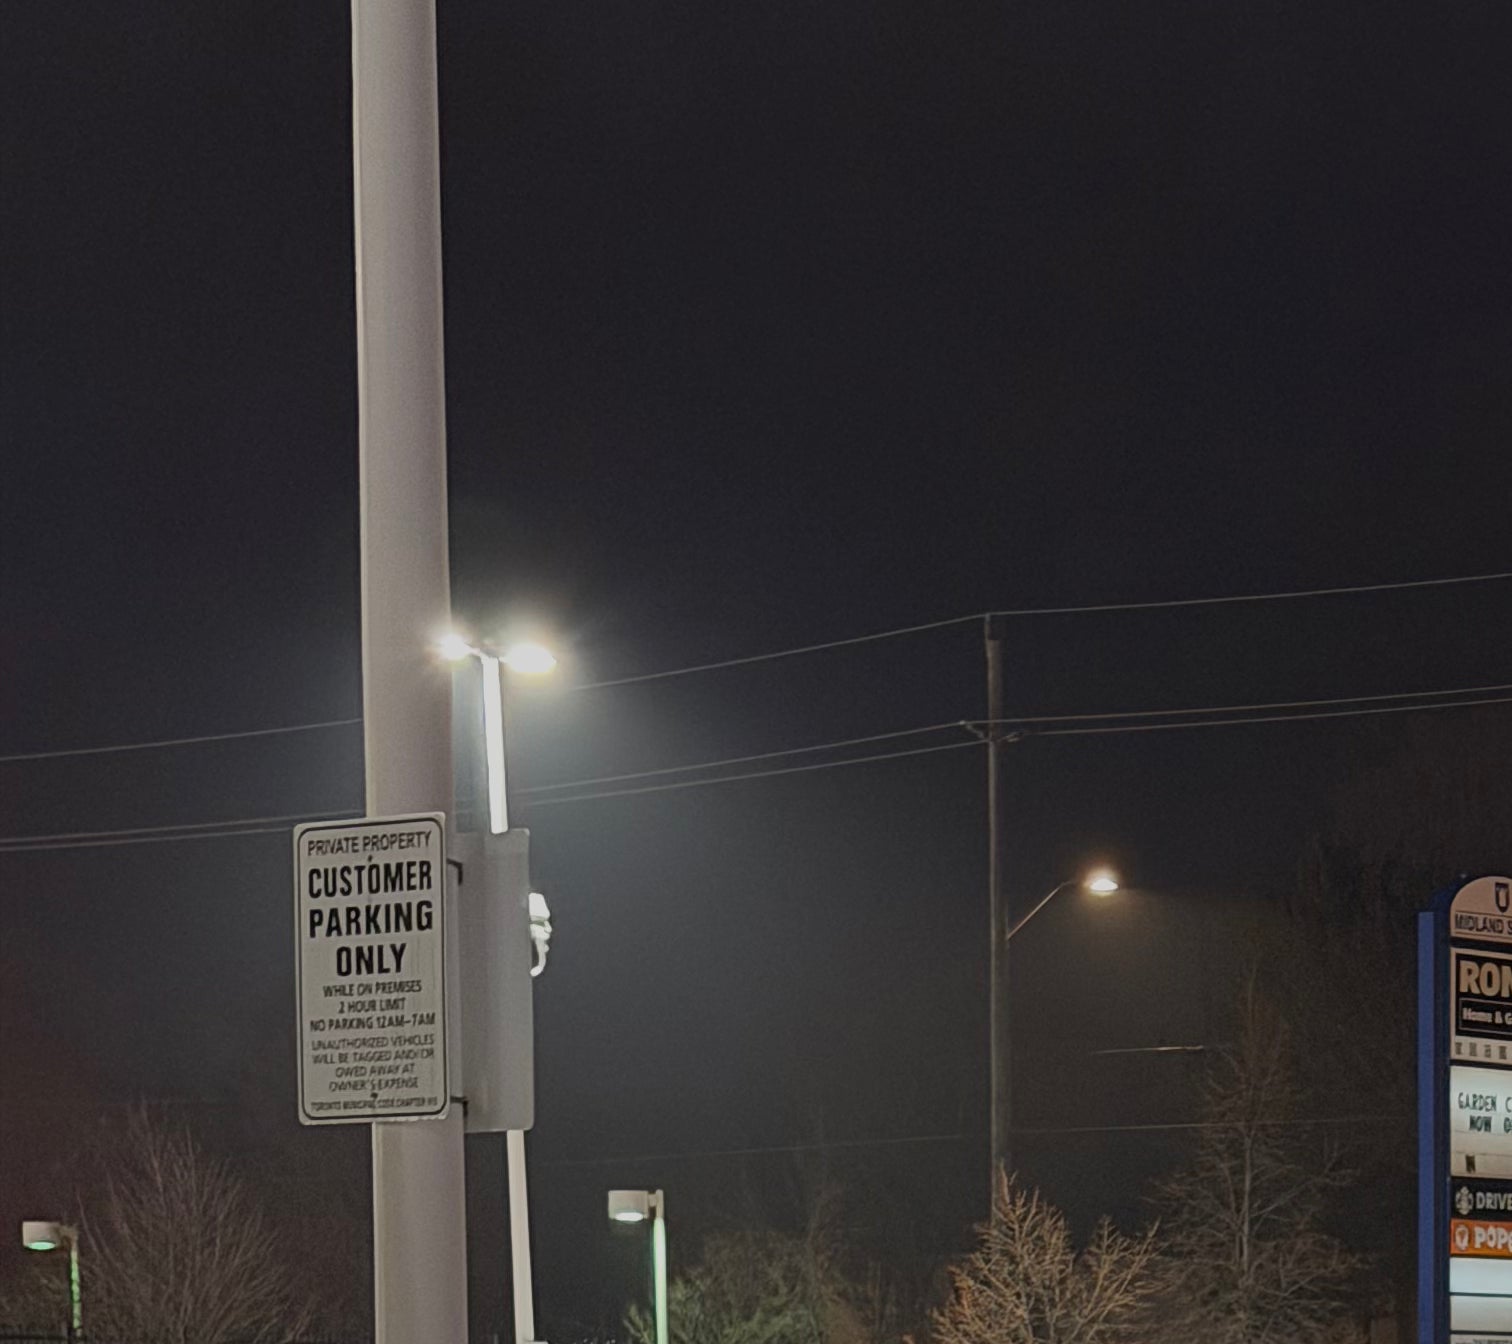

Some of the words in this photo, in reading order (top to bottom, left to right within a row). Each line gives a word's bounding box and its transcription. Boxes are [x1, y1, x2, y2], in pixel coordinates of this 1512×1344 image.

[307, 836, 359, 856] PRIVATE
[362, 830, 432, 851] PROPERTY
[308, 860, 432, 899] CUSTOMER
[309, 900, 433, 938] PARKING
[1455, 913, 1505, 934] MIDLAND
[336, 942, 407, 977] ONLY
[322, 984, 355, 998] WHILE
[357, 983, 373, 996] ON
[375, 980, 423, 995] PREMISES
[338, 1000, 345, 1014] 2
[347, 999, 377, 1013] HOUR
[379, 997, 406, 1012] LIMIT
[310, 1019, 326, 1032] NO
[328, 1017, 374, 1030] PARKING
[1462, 1007, 1493, 1023] Home
[1494, 1010, 1503, 1024] &
[311, 1036, 389, 1051] UNAUTHORIZED
[390, 1033, 435, 1047] VEHICLES
[312, 1053, 336, 1065] WILL
[338, 1052, 349, 1064] BE
[352, 1050, 392, 1063] TAGGED
[369, 1064, 400, 1077] AWAY
[401, 1063, 415, 1075] AT
[378, 1076, 419, 1091] EXPENSE
[1458, 1092, 1498, 1112] GARDEN
[1469, 1115, 1492, 1132] NOW
